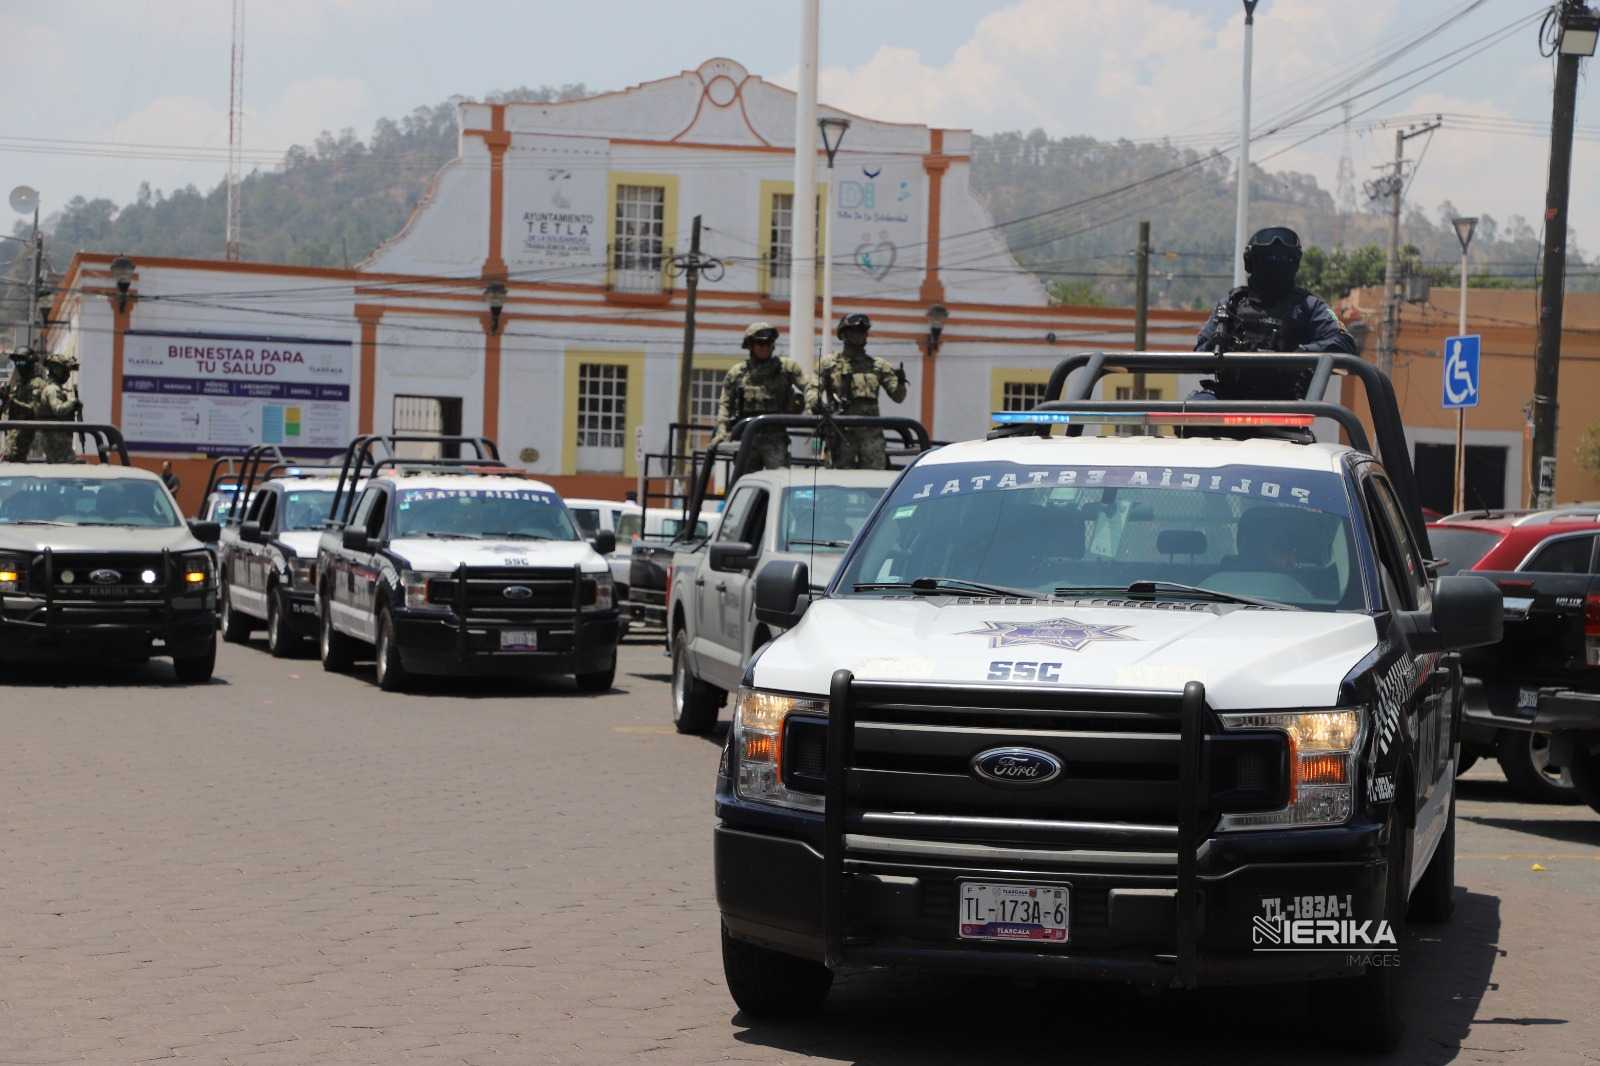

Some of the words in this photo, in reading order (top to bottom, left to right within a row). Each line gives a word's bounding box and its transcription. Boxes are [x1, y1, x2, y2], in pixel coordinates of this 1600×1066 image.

[523, 211, 593, 224] AYUNTAMIENTO
[528, 221, 589, 235] TETLA
[168, 345, 255, 362] BIENESTAR
[261, 350, 304, 364] PARA
[196, 361, 216, 374] TU
[223, 361, 276, 376] SALUD
[987, 661, 1063, 682] SSC
[994, 756, 1039, 777] Ford
[964, 898, 1064, 924] TL-173A-6
[1262, 895, 1353, 921] TL-183A-1
